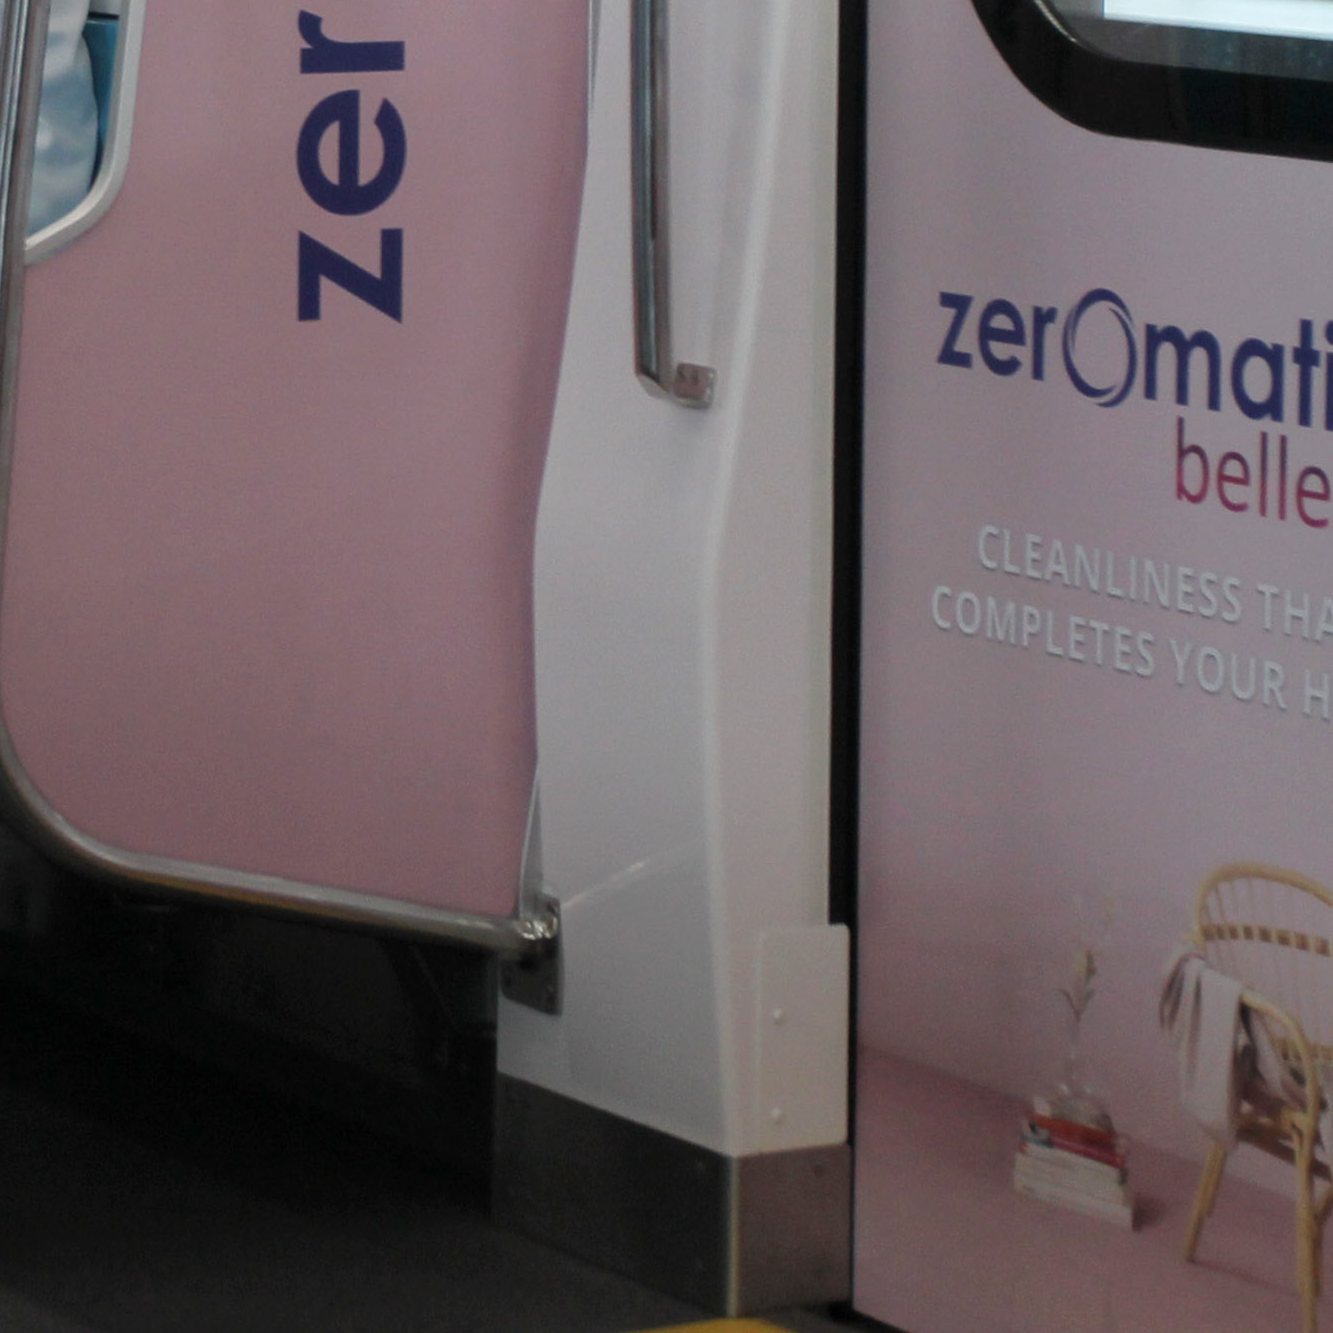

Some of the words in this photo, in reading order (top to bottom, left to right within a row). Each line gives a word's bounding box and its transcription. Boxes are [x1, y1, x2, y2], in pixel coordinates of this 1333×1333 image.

[1176, 416, 1331, 528] belle
[978, 525, 1242, 623] CLEANLINESS
[934, 586, 1157, 677] COMPLETES
[1170, 637, 1288, 710] YOUR
